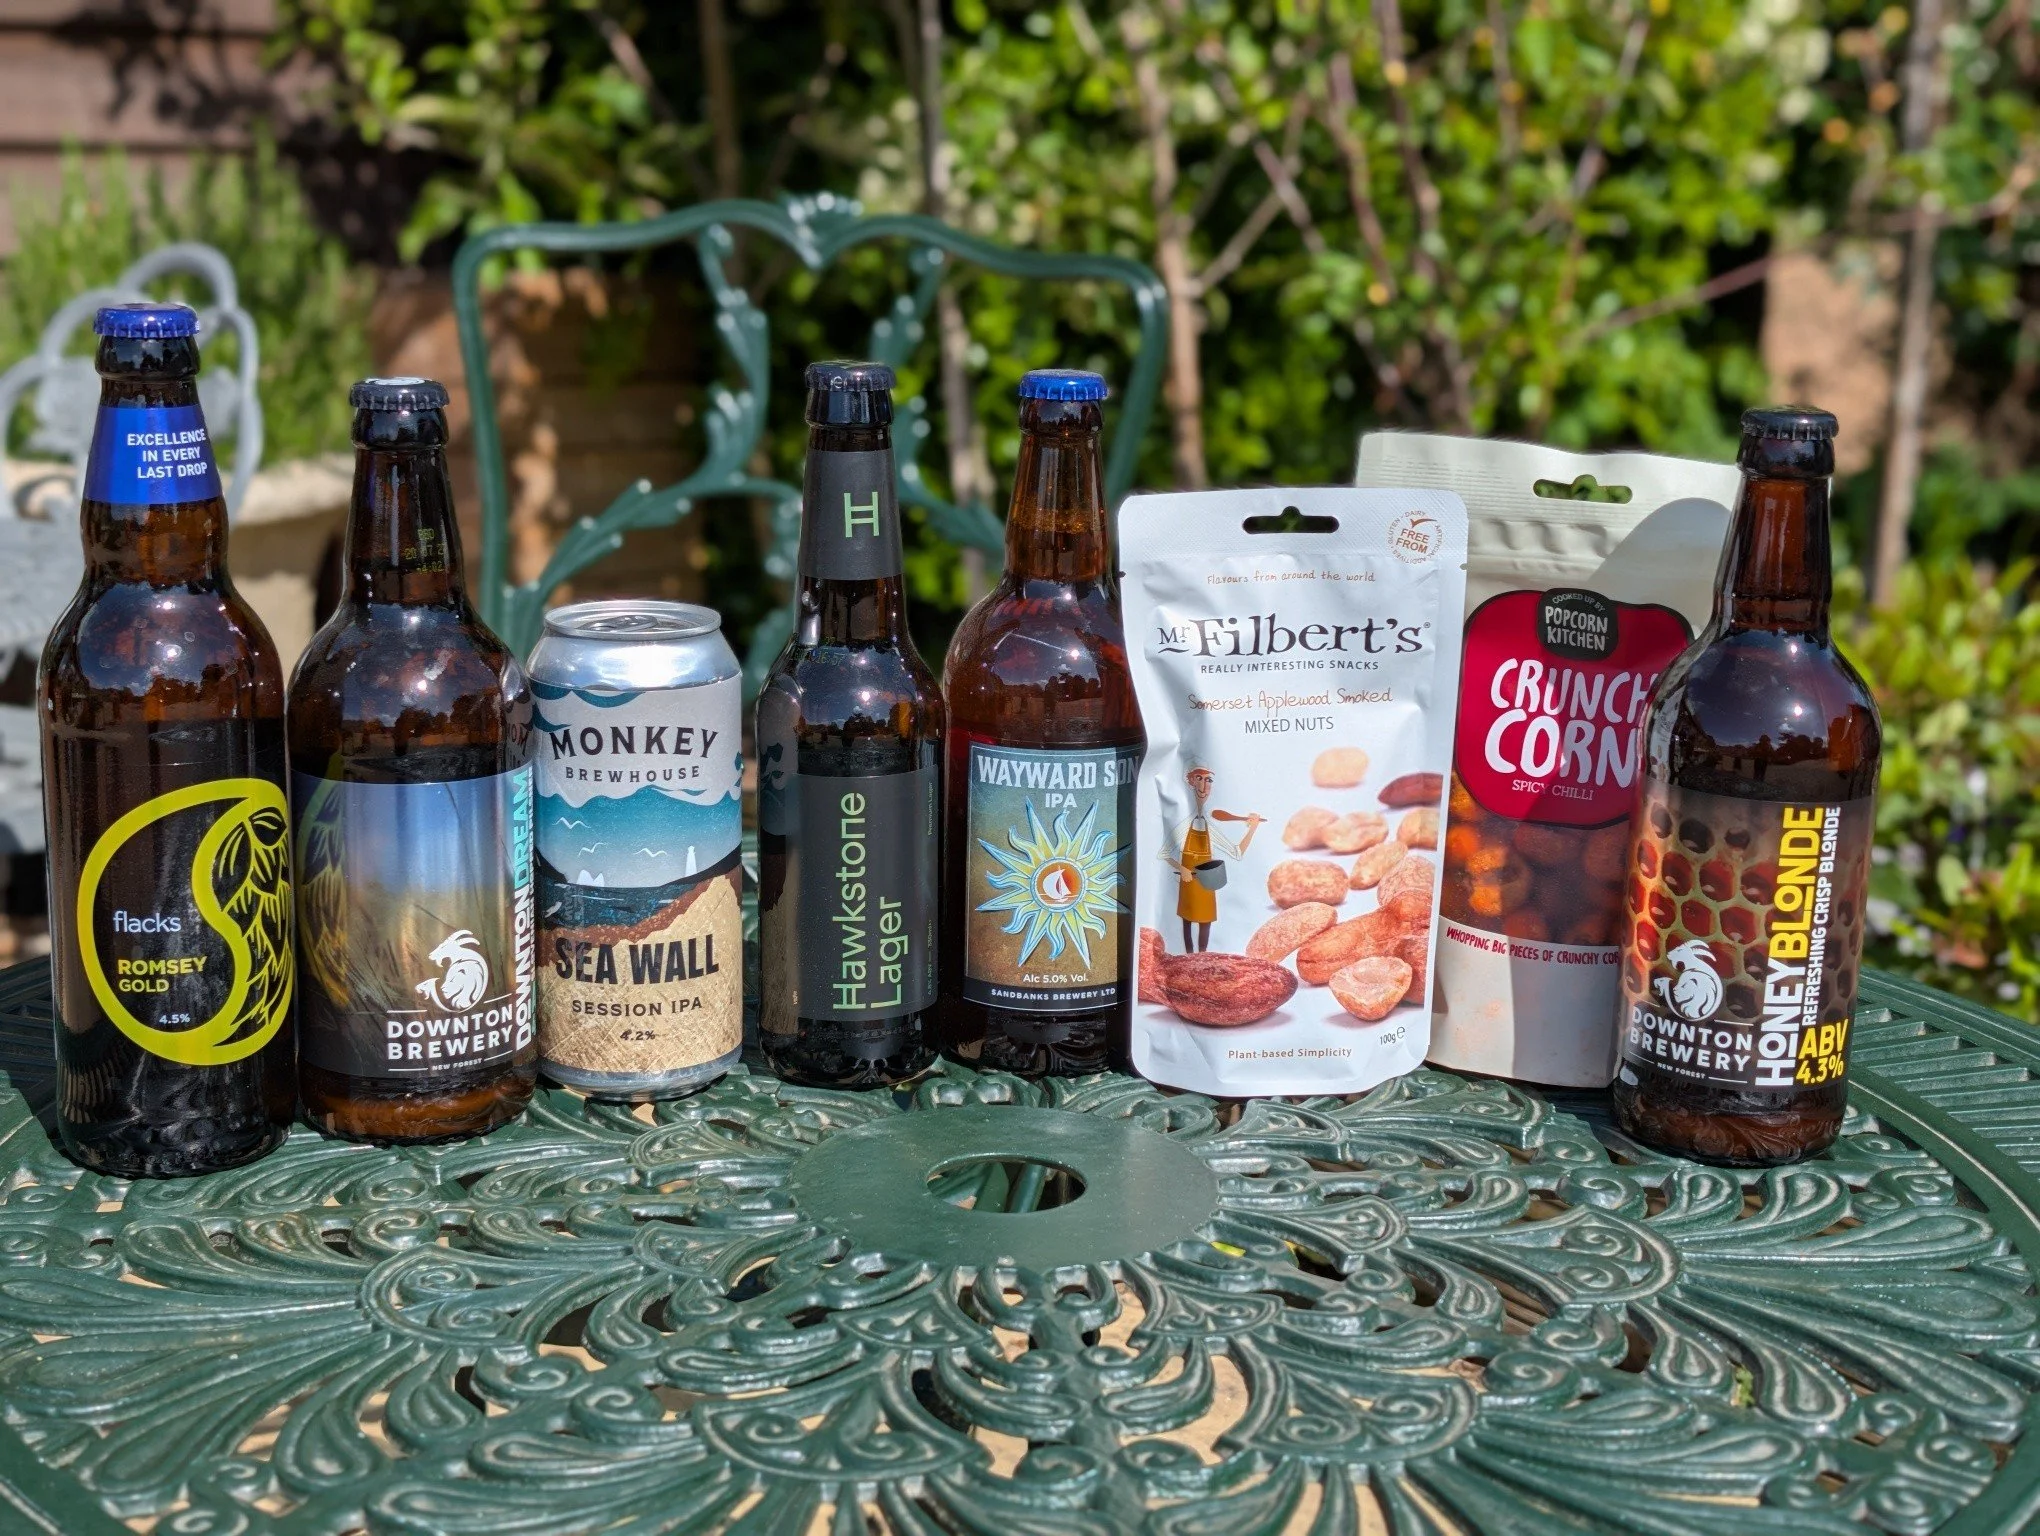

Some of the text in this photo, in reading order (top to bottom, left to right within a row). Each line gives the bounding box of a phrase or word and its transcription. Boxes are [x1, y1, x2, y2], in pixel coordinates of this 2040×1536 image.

[127, 429, 206, 446] EXCELLENCE
[142, 446, 201, 462] IN EVERY
[137, 461, 208, 479] LAST DROP
[1395, 537, 1429, 554] FROM
[1401, 528, 1430, 544] FREE
[1207, 569, 1376, 585] Flavours from around the world
[1552, 592, 1583, 604] COOKED
[1545, 605, 1609, 634] POPCORN
[1188, 612, 1423, 658] Filbert's
[1547, 626, 1606, 652] KITCHEN
[1201, 659, 1380, 674] REALLY INTERESTING SNACKS
[1187, 686, 1394, 717] Somerset Applewood Smoked
[1490, 658, 1660, 724] CRUNCH
[1244, 716, 1335, 735] MIXED NUTS
[548, 725, 719, 761] MONKEY
[1484, 708, 1638, 789] CORN
[565, 765, 700, 783] BREWHOUSE
[977, 754, 1141, 790] WAYWARD SON
[1511, 778, 1595, 801] SPICY CHILLI
[1045, 793, 1078, 808] IPA
[832, 791, 867, 1010] Hawkstone
[1802, 806, 1841, 1026] REFRESHING CRISP BLONDE
[870, 896, 909, 1009] Lager
[1446, 926, 1490, 950] WHOPPING
[1492, 939, 1507, 955] BIG
[1509, 946, 1540, 961] PIECES
[1543, 950, 1554, 962] OF
[1556, 951, 1600, 965] CRUNCHY
[117, 955, 208, 976] ROMSEY
[555, 937, 618, 985] SEA
[629, 933, 720, 985] WALL
[119, 979, 170, 993] GOLD
[1023, 972, 1089, 984] Alc 5.0% Vol.
[991, 986, 1116, 1001] SANDBANKS BREWERY LTD
[572, 996, 703, 1017] SESSION IPA
[159, 1013, 191, 1024] 4.5%
[387, 1003, 513, 1039] DOWNTON
[1632, 1005, 1753, 1051] DOWNTON
[387, 1024, 513, 1060] BREWERY
[619, 1029, 656, 1041] 4.2%
[1798, 1018, 1849, 1060] ABV
[1228, 1047, 1352, 1060] Plant-based Simplicity
[1629, 1026, 1752, 1072] BREWERY
[432, 1058, 483, 1071] NEW FOREST
[1656, 1062, 1706, 1079] NEW FOREST
[1795, 1052, 1844, 1085] 4.3%
